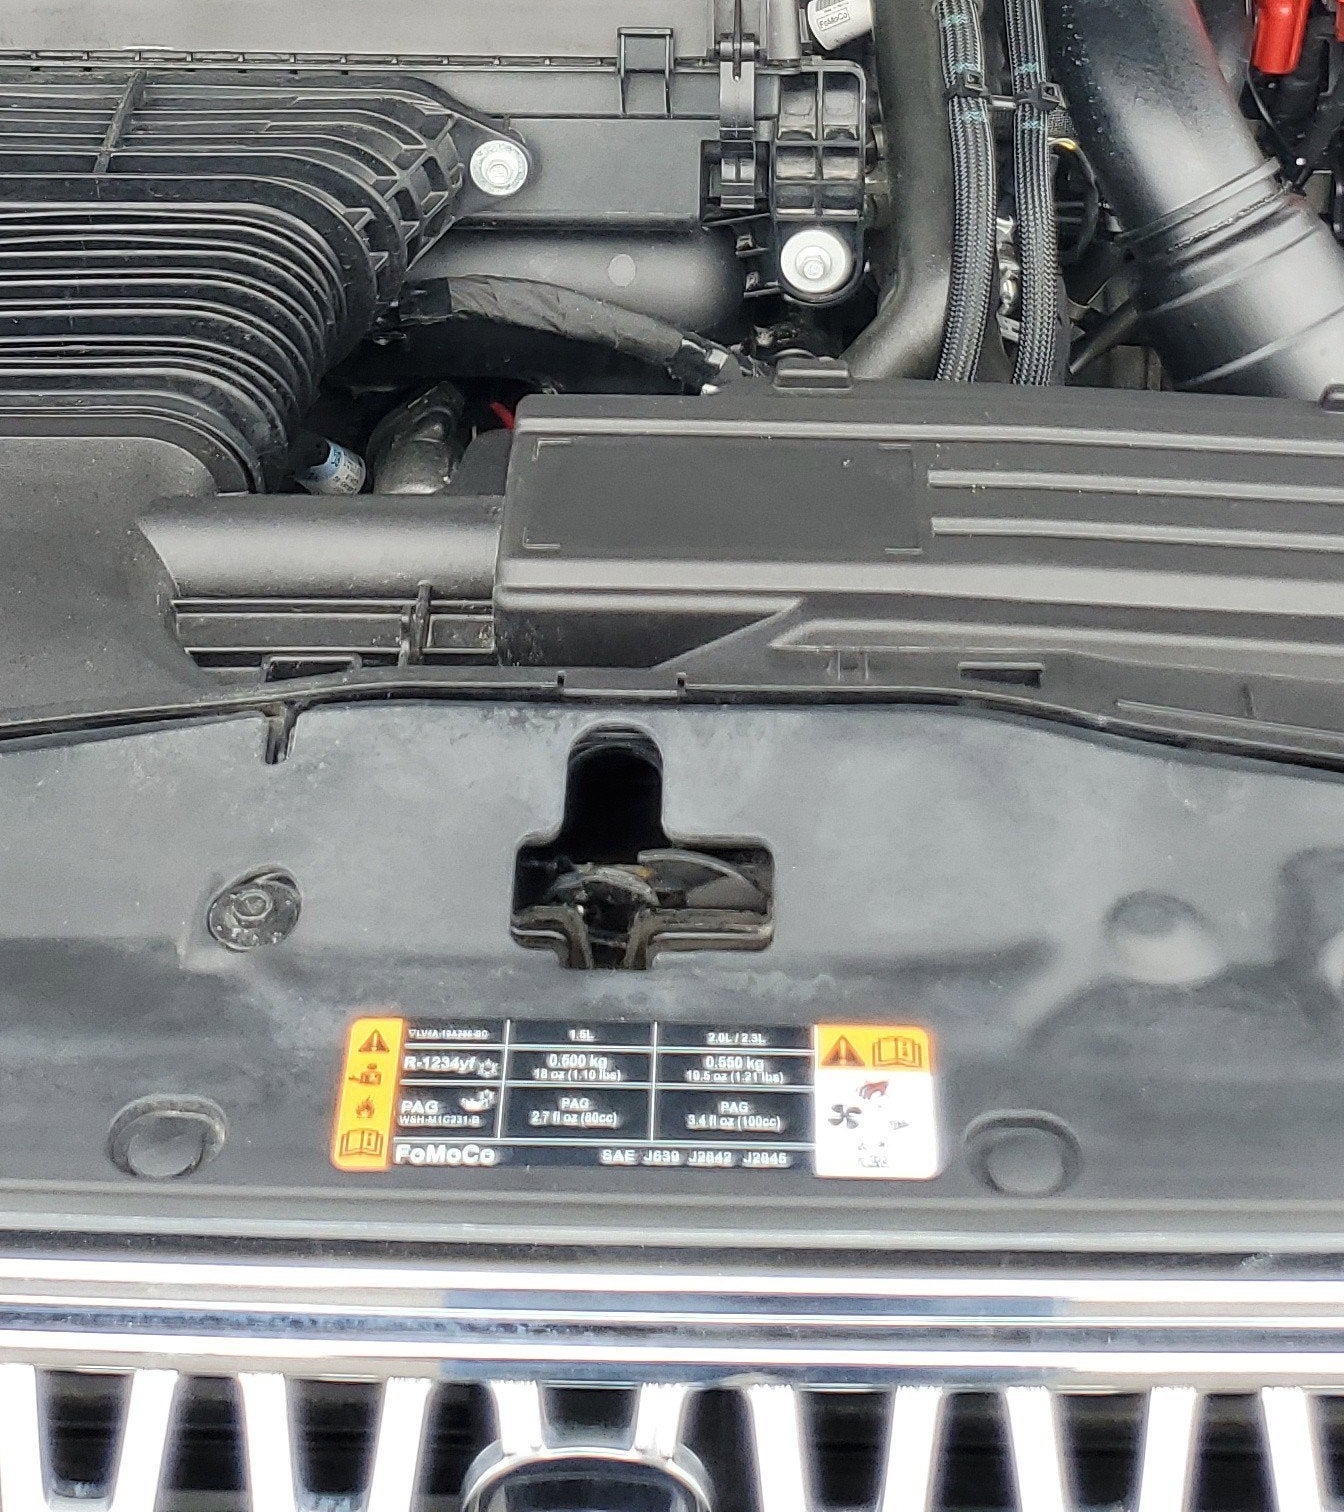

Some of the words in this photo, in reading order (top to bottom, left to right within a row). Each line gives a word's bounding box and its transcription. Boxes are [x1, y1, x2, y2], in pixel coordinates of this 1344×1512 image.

[568, 1029, 594, 1041] 1.5L
[708, 1032, 732, 1044] 2.0L
[741, 1033, 766, 1045] 2.3L
[404, 1056, 476, 1074] R-1234yf
[589, 1054, 608, 1071] kg
[746, 1056, 765, 1073] kg
[550, 1071, 565, 1080] oz
[567, 1069, 596, 1082] (1.10
[599, 1069, 621, 1082] lbs)
[713, 1073, 728, 1082] oz
[761, 1071, 784, 1085] lbs)
[400, 1100, 439, 1115] PAG
[560, 1097, 590, 1110] PAG
[720, 1101, 749, 1114] PAG
[563, 1114, 578, 1124] oz
[719, 1117, 735, 1128] oz
[737, 1115, 782, 1133] (100cc)
[395, 1143, 496, 1166] FoMoCo
[601, 1148, 635, 1163] SAE
